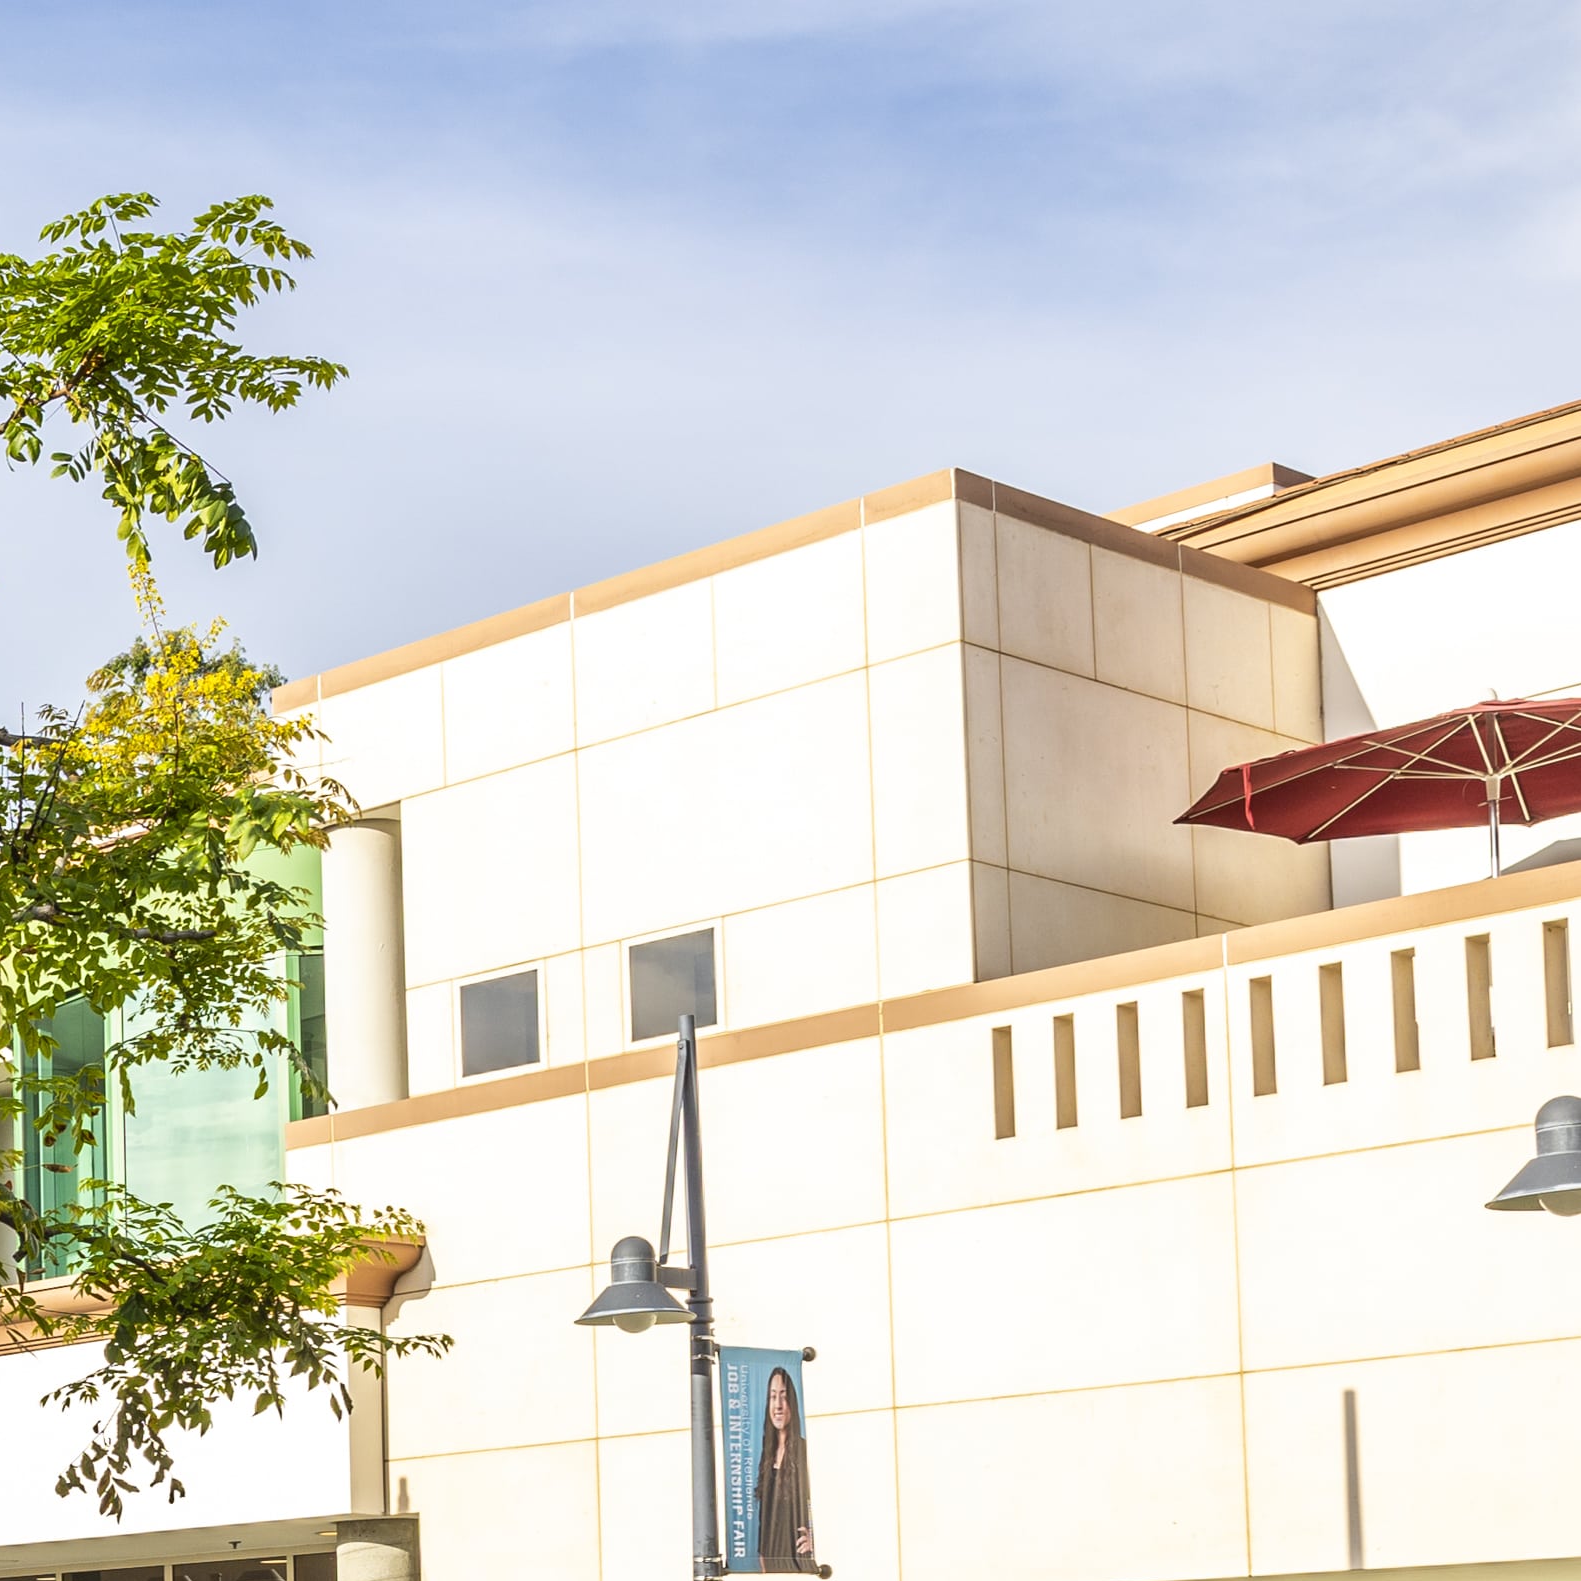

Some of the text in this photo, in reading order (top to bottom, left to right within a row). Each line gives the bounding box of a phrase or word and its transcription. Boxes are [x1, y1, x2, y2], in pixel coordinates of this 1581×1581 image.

[740, 1364, 752, 1437] University
[727, 1363, 746, 1559] JOB & INTERNSHIP FAIR
[743, 1439, 753, 1454] of
